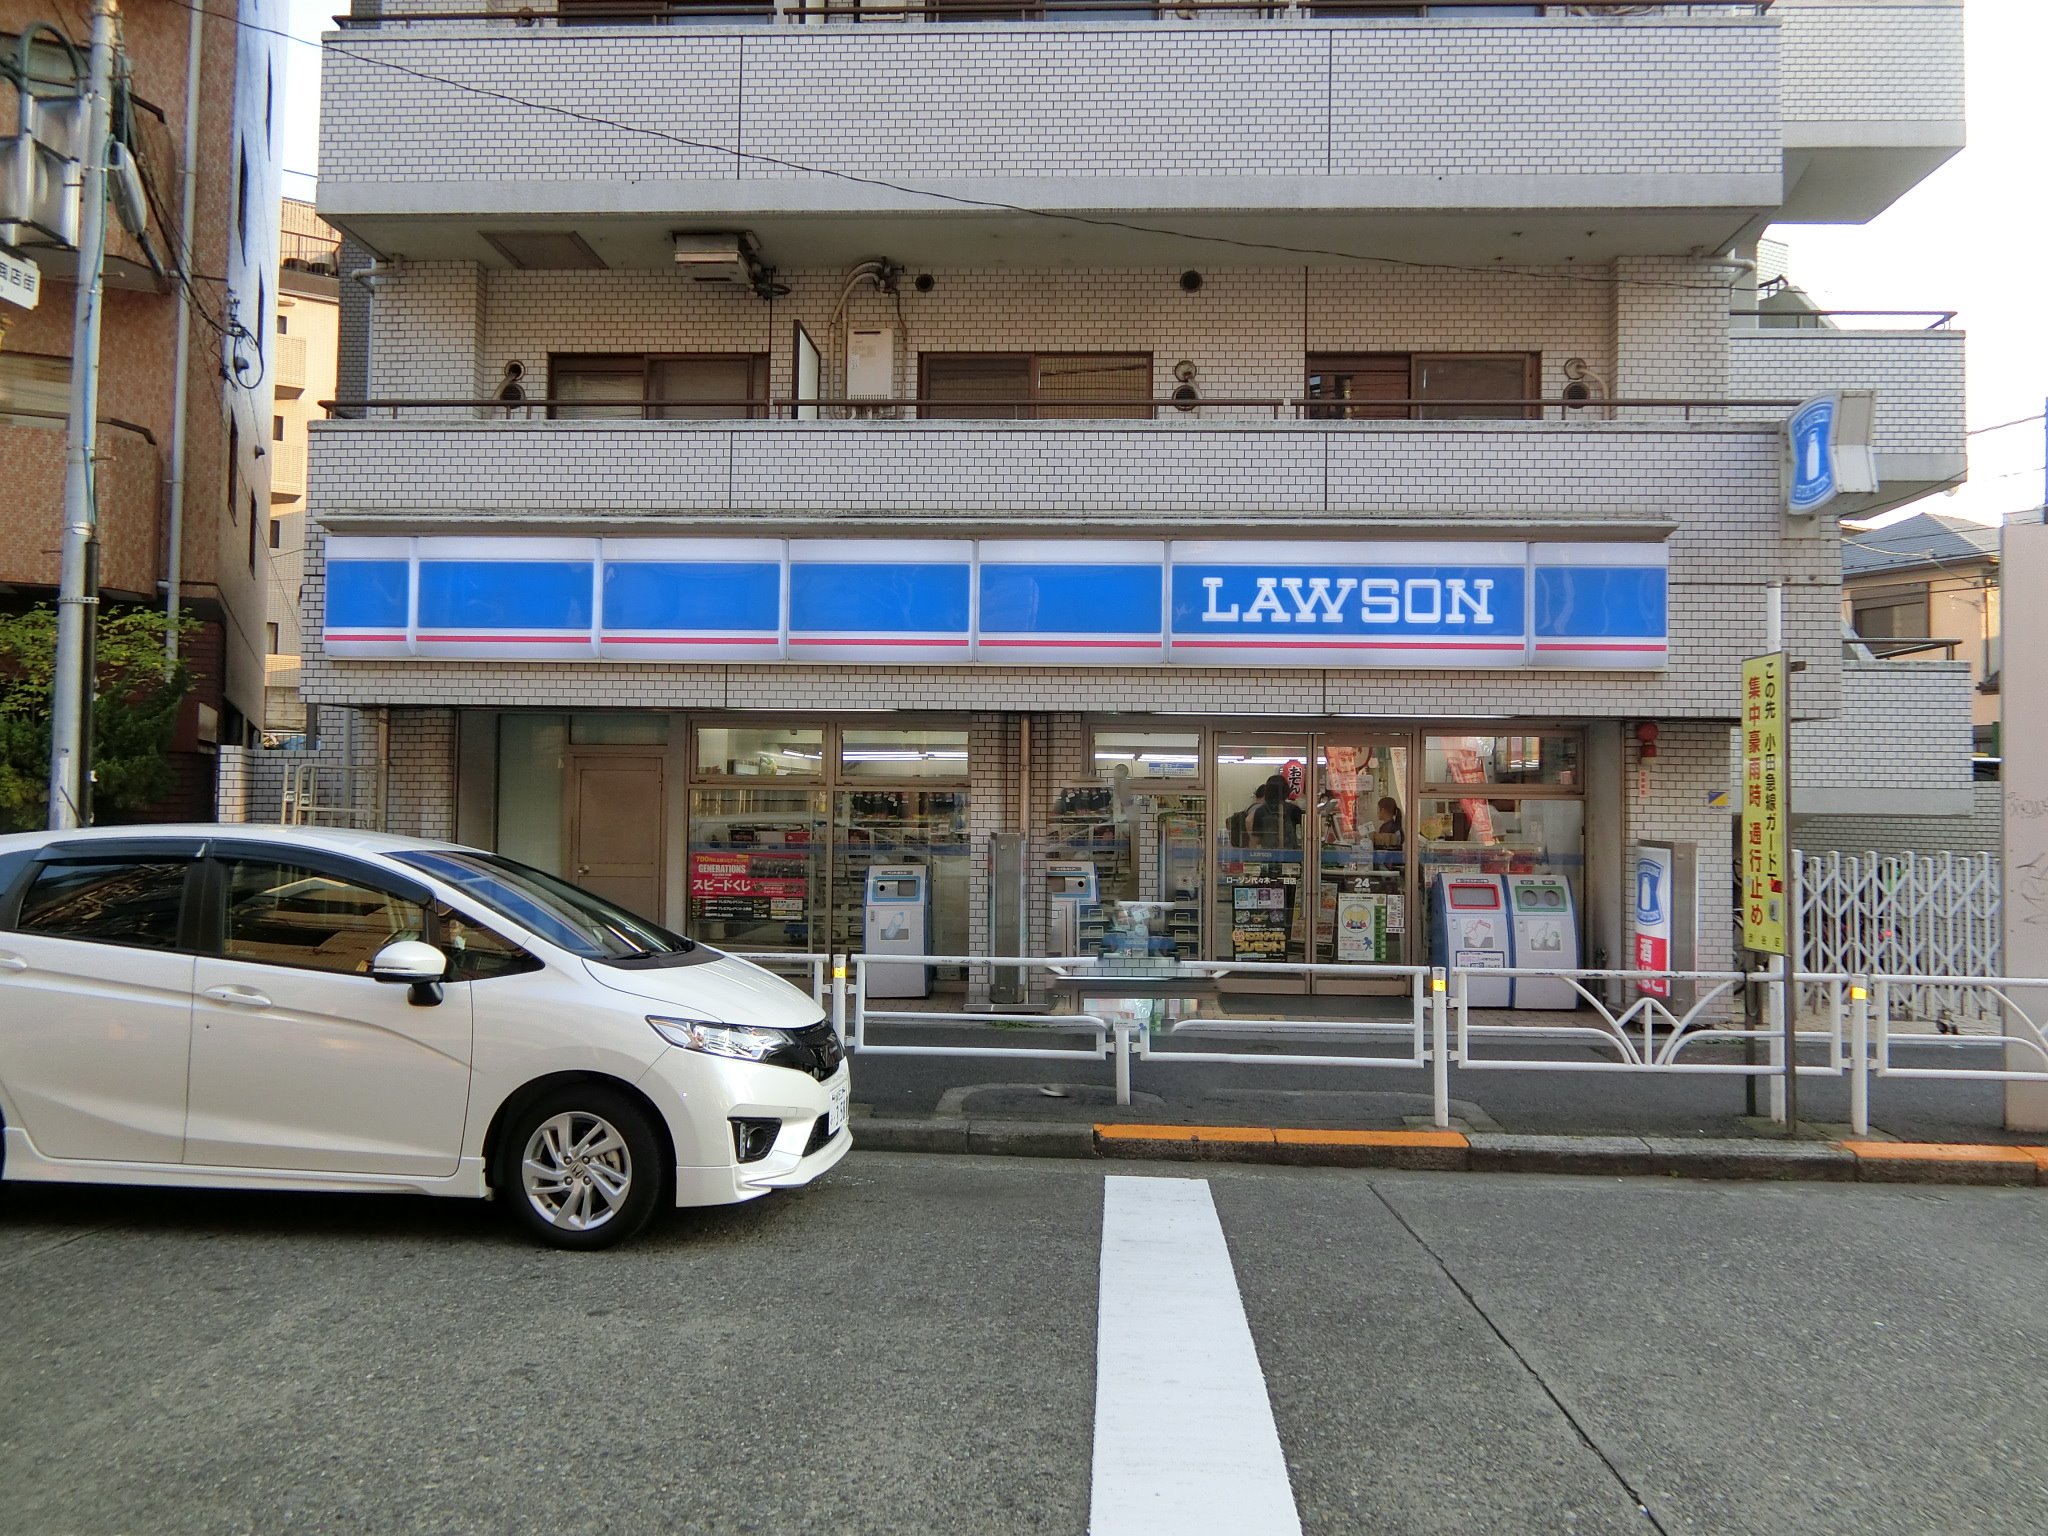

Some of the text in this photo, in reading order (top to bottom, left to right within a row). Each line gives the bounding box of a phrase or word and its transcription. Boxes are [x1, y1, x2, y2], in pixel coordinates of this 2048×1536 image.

[1202, 577, 1494, 624] LAWSON
[1765, 662, 1776, 720] この先
[1289, 765, 1302, 795] おでん
[698, 864, 746, 874] GENERATIONS
[1354, 877, 1370, 888] 24
[1749, 821, 1763, 926] 通行止め
[692, 879, 751, 891] スピードくじ
